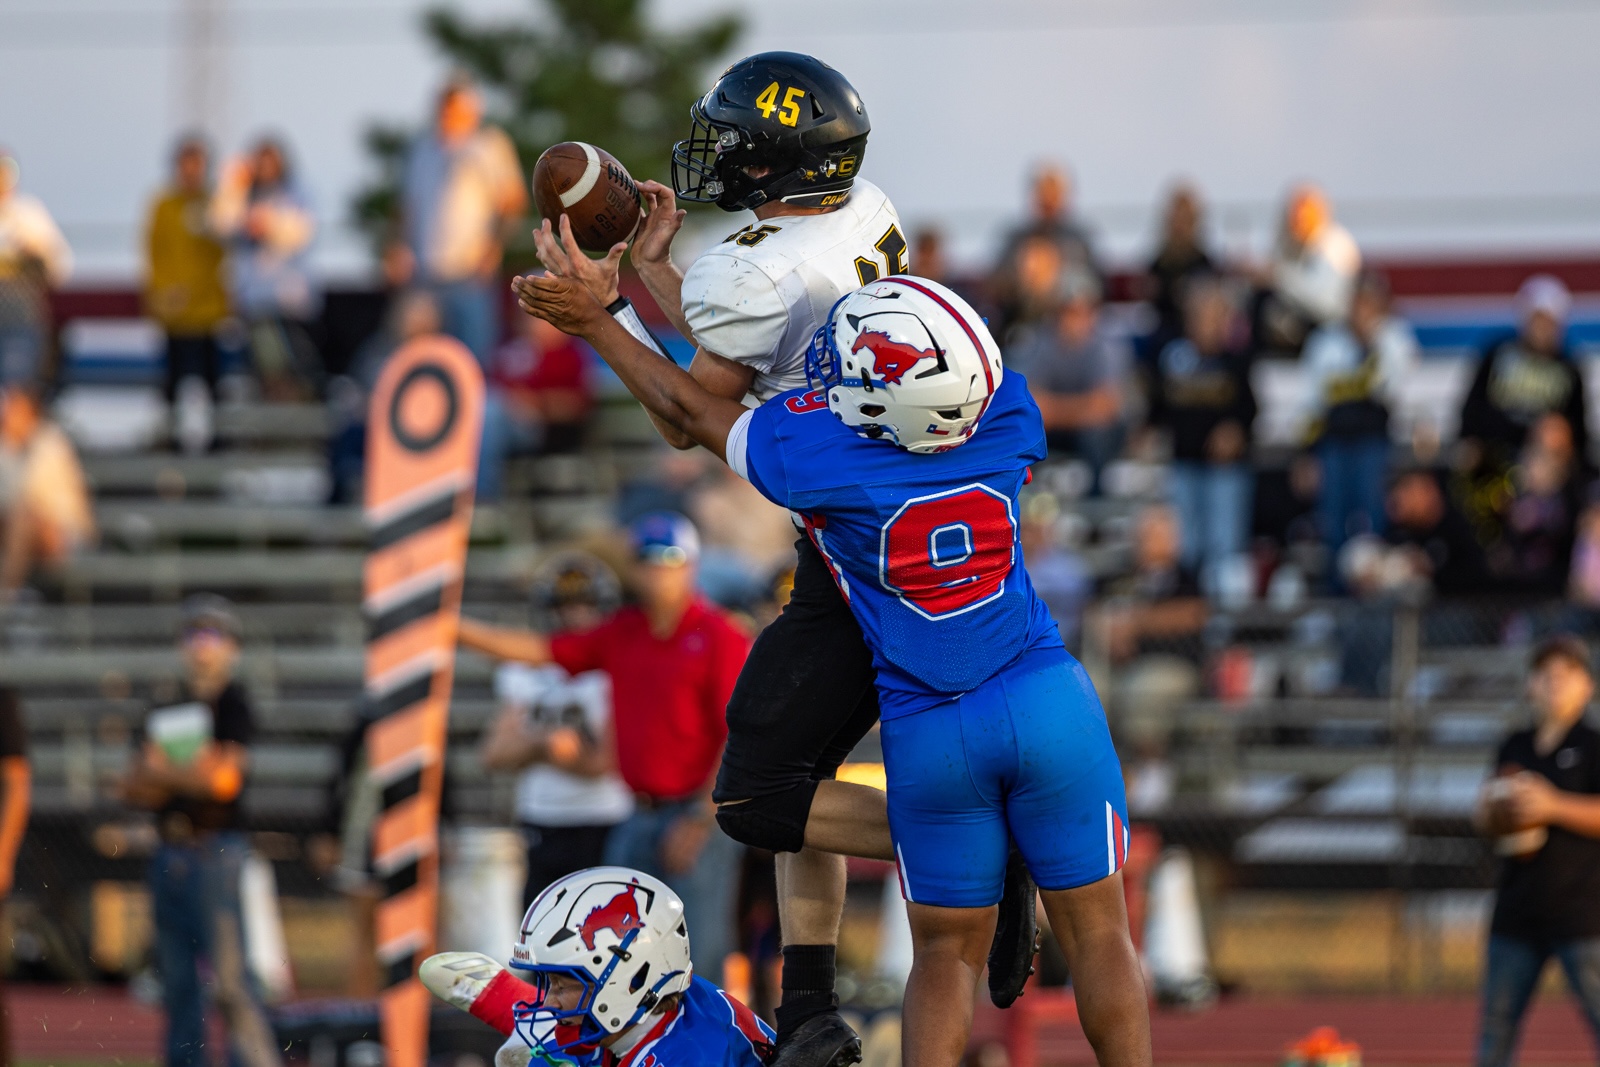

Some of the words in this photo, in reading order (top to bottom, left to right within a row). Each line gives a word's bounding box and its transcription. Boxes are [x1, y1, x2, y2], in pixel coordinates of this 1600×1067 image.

[755, 81, 806, 128] 45
[838, 156, 857, 176] C
[594, 212, 618, 234] GST
